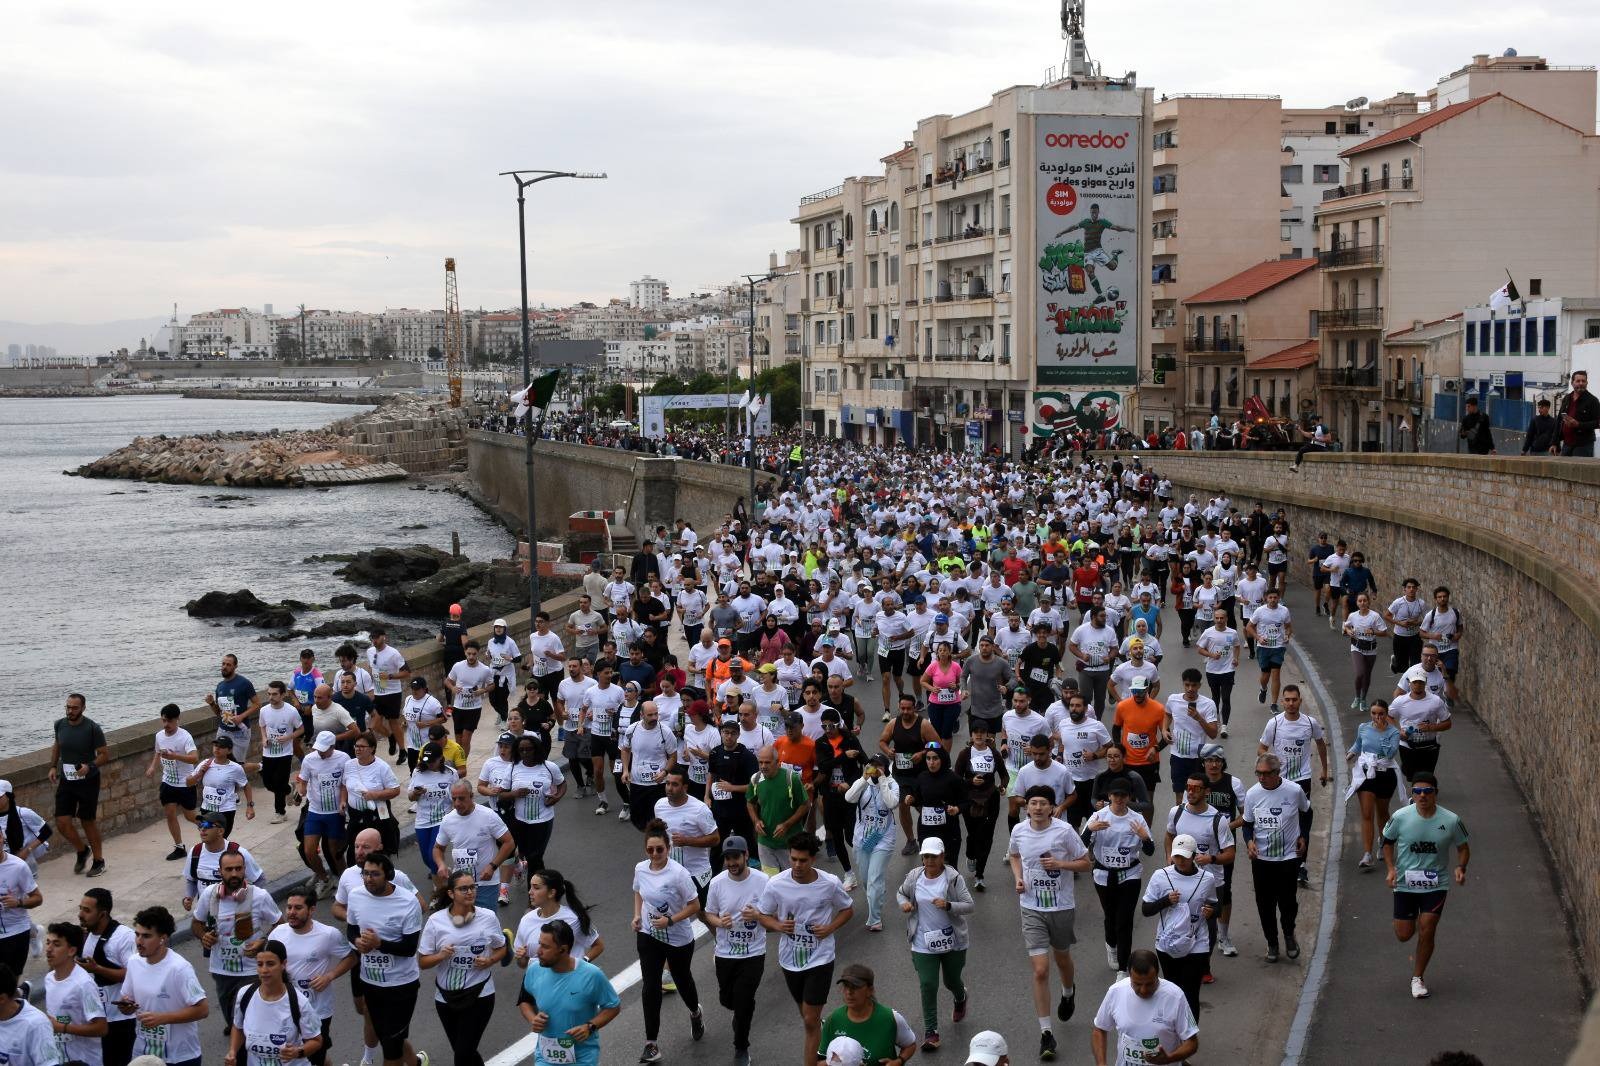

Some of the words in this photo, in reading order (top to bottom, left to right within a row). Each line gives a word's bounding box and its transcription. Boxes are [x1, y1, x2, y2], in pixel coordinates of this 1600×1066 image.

[1045, 130, 1129, 149] ooredoo
[1039, 162, 1083, 174] مولودية
[1084, 164, 1103, 173] SIM
[1063, 176, 1080, 186] des
[1081, 177, 1107, 188] gigas
[1054, 190, 1069, 198] SIM
[321, 779, 339, 787] 5677
[205, 794, 222, 802] 4574
[864, 814, 884, 824] 3975
[923, 814, 943, 822] 3262
[456, 857, 474, 865] 5977
[1105, 855, 1127, 864] 3743
[1033, 879, 1057, 887] 2865
[729, 930, 753, 939] 3439
[930, 936, 953, 948] 4056
[364, 955, 390, 964] 3568
[452, 957, 475, 965] 482
[250, 1044, 281, 1055] 4128
[547, 1049, 567, 1059] 188
